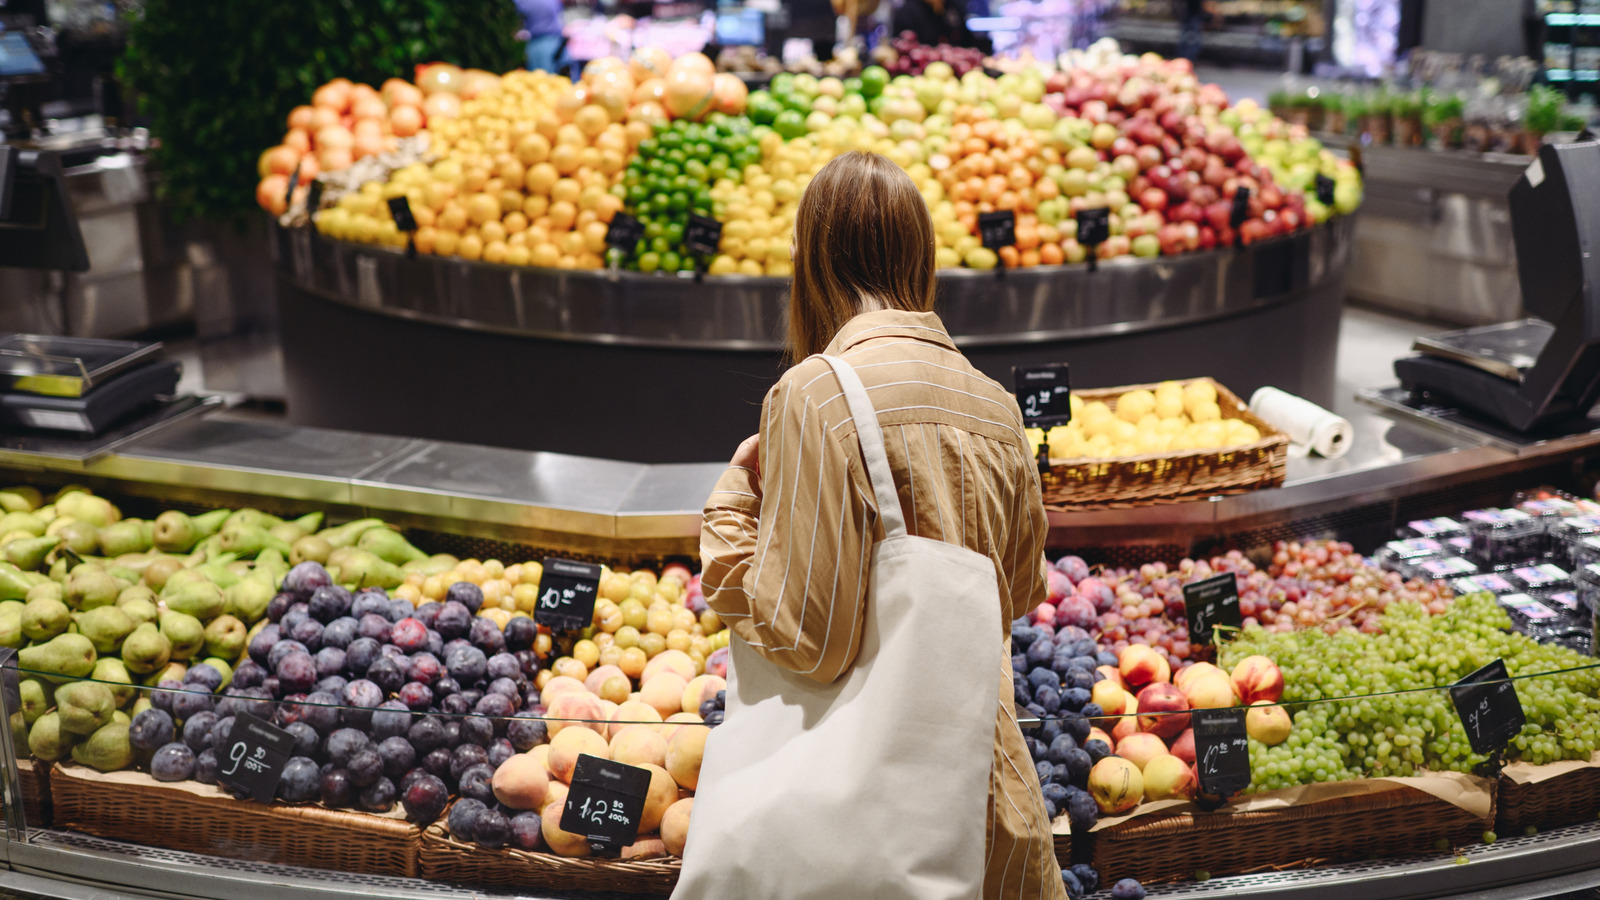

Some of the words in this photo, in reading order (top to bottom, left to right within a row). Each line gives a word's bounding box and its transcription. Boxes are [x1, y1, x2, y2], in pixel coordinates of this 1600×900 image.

[540, 587, 560, 609] 10
[221, 741, 247, 775] 9
[580, 796, 608, 825] 12
